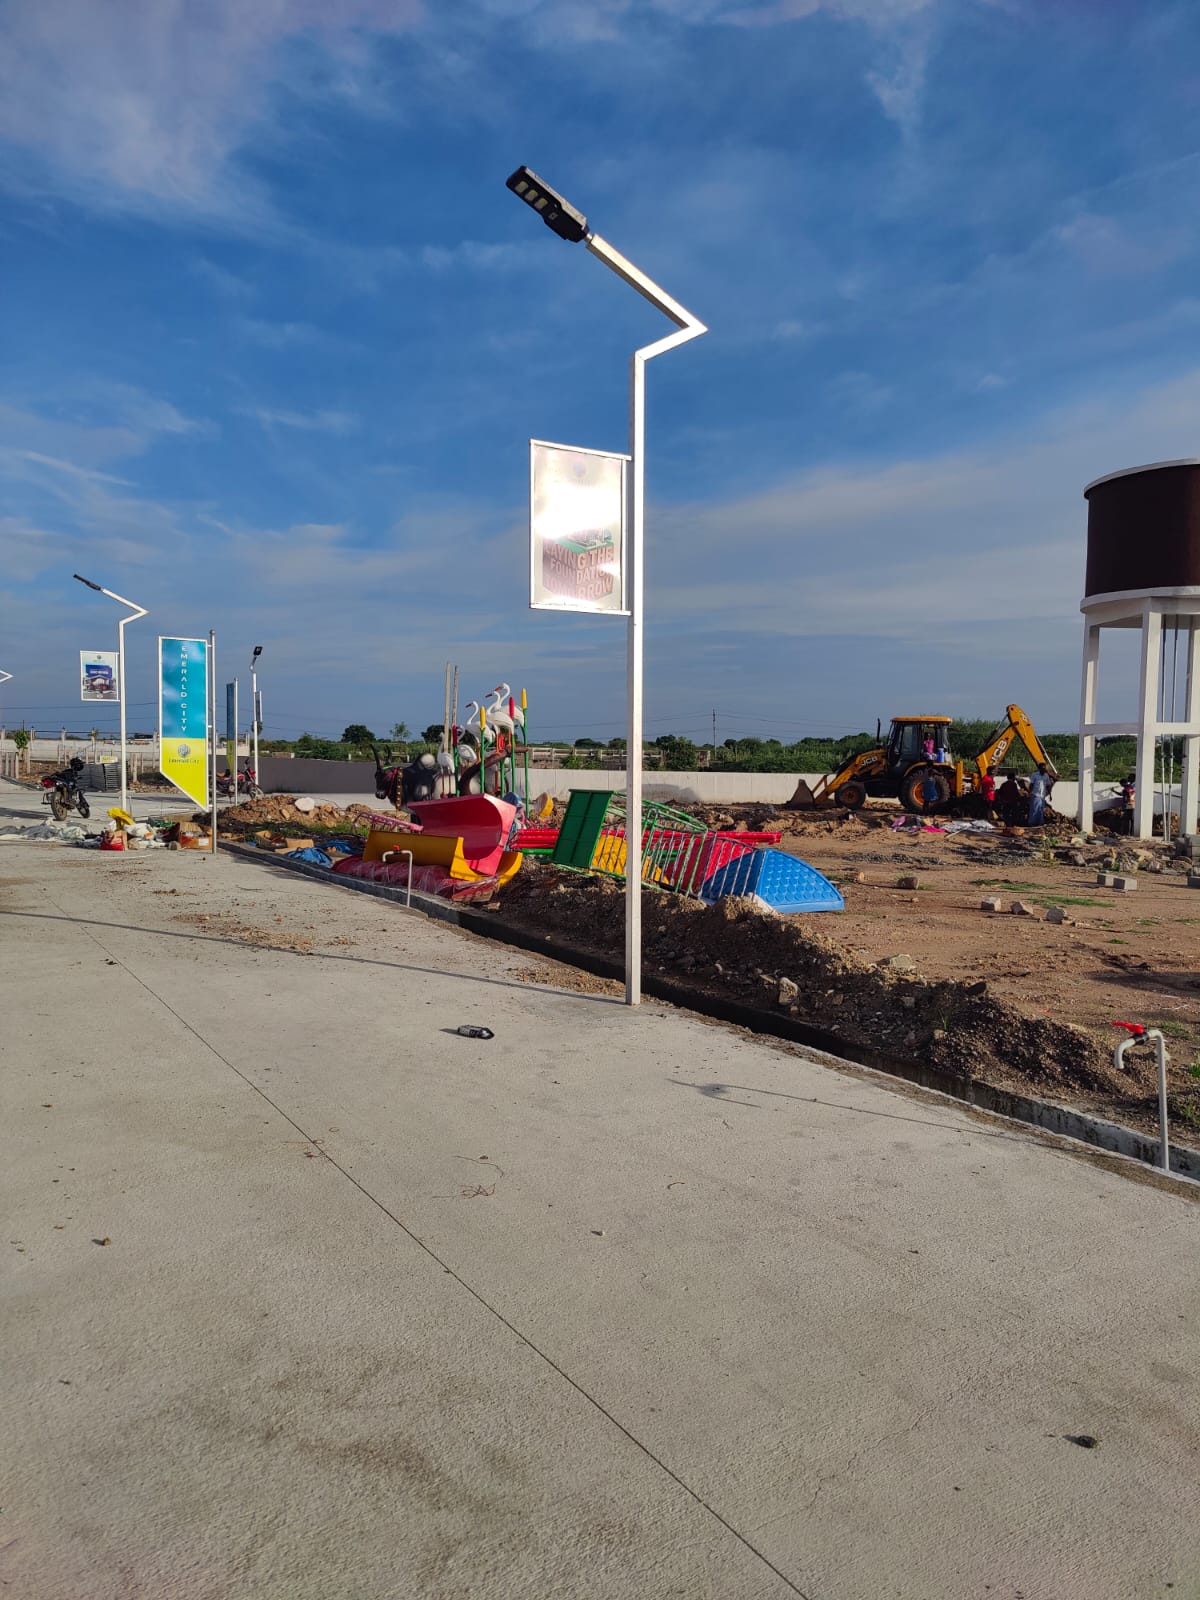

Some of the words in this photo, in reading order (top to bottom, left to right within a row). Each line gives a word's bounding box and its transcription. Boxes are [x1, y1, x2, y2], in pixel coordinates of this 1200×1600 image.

[545, 542, 587, 570] LAYING
[590, 546, 614, 566] THE
[862, 756, 878, 766] JCB
[992, 740, 1007, 766] JCB
